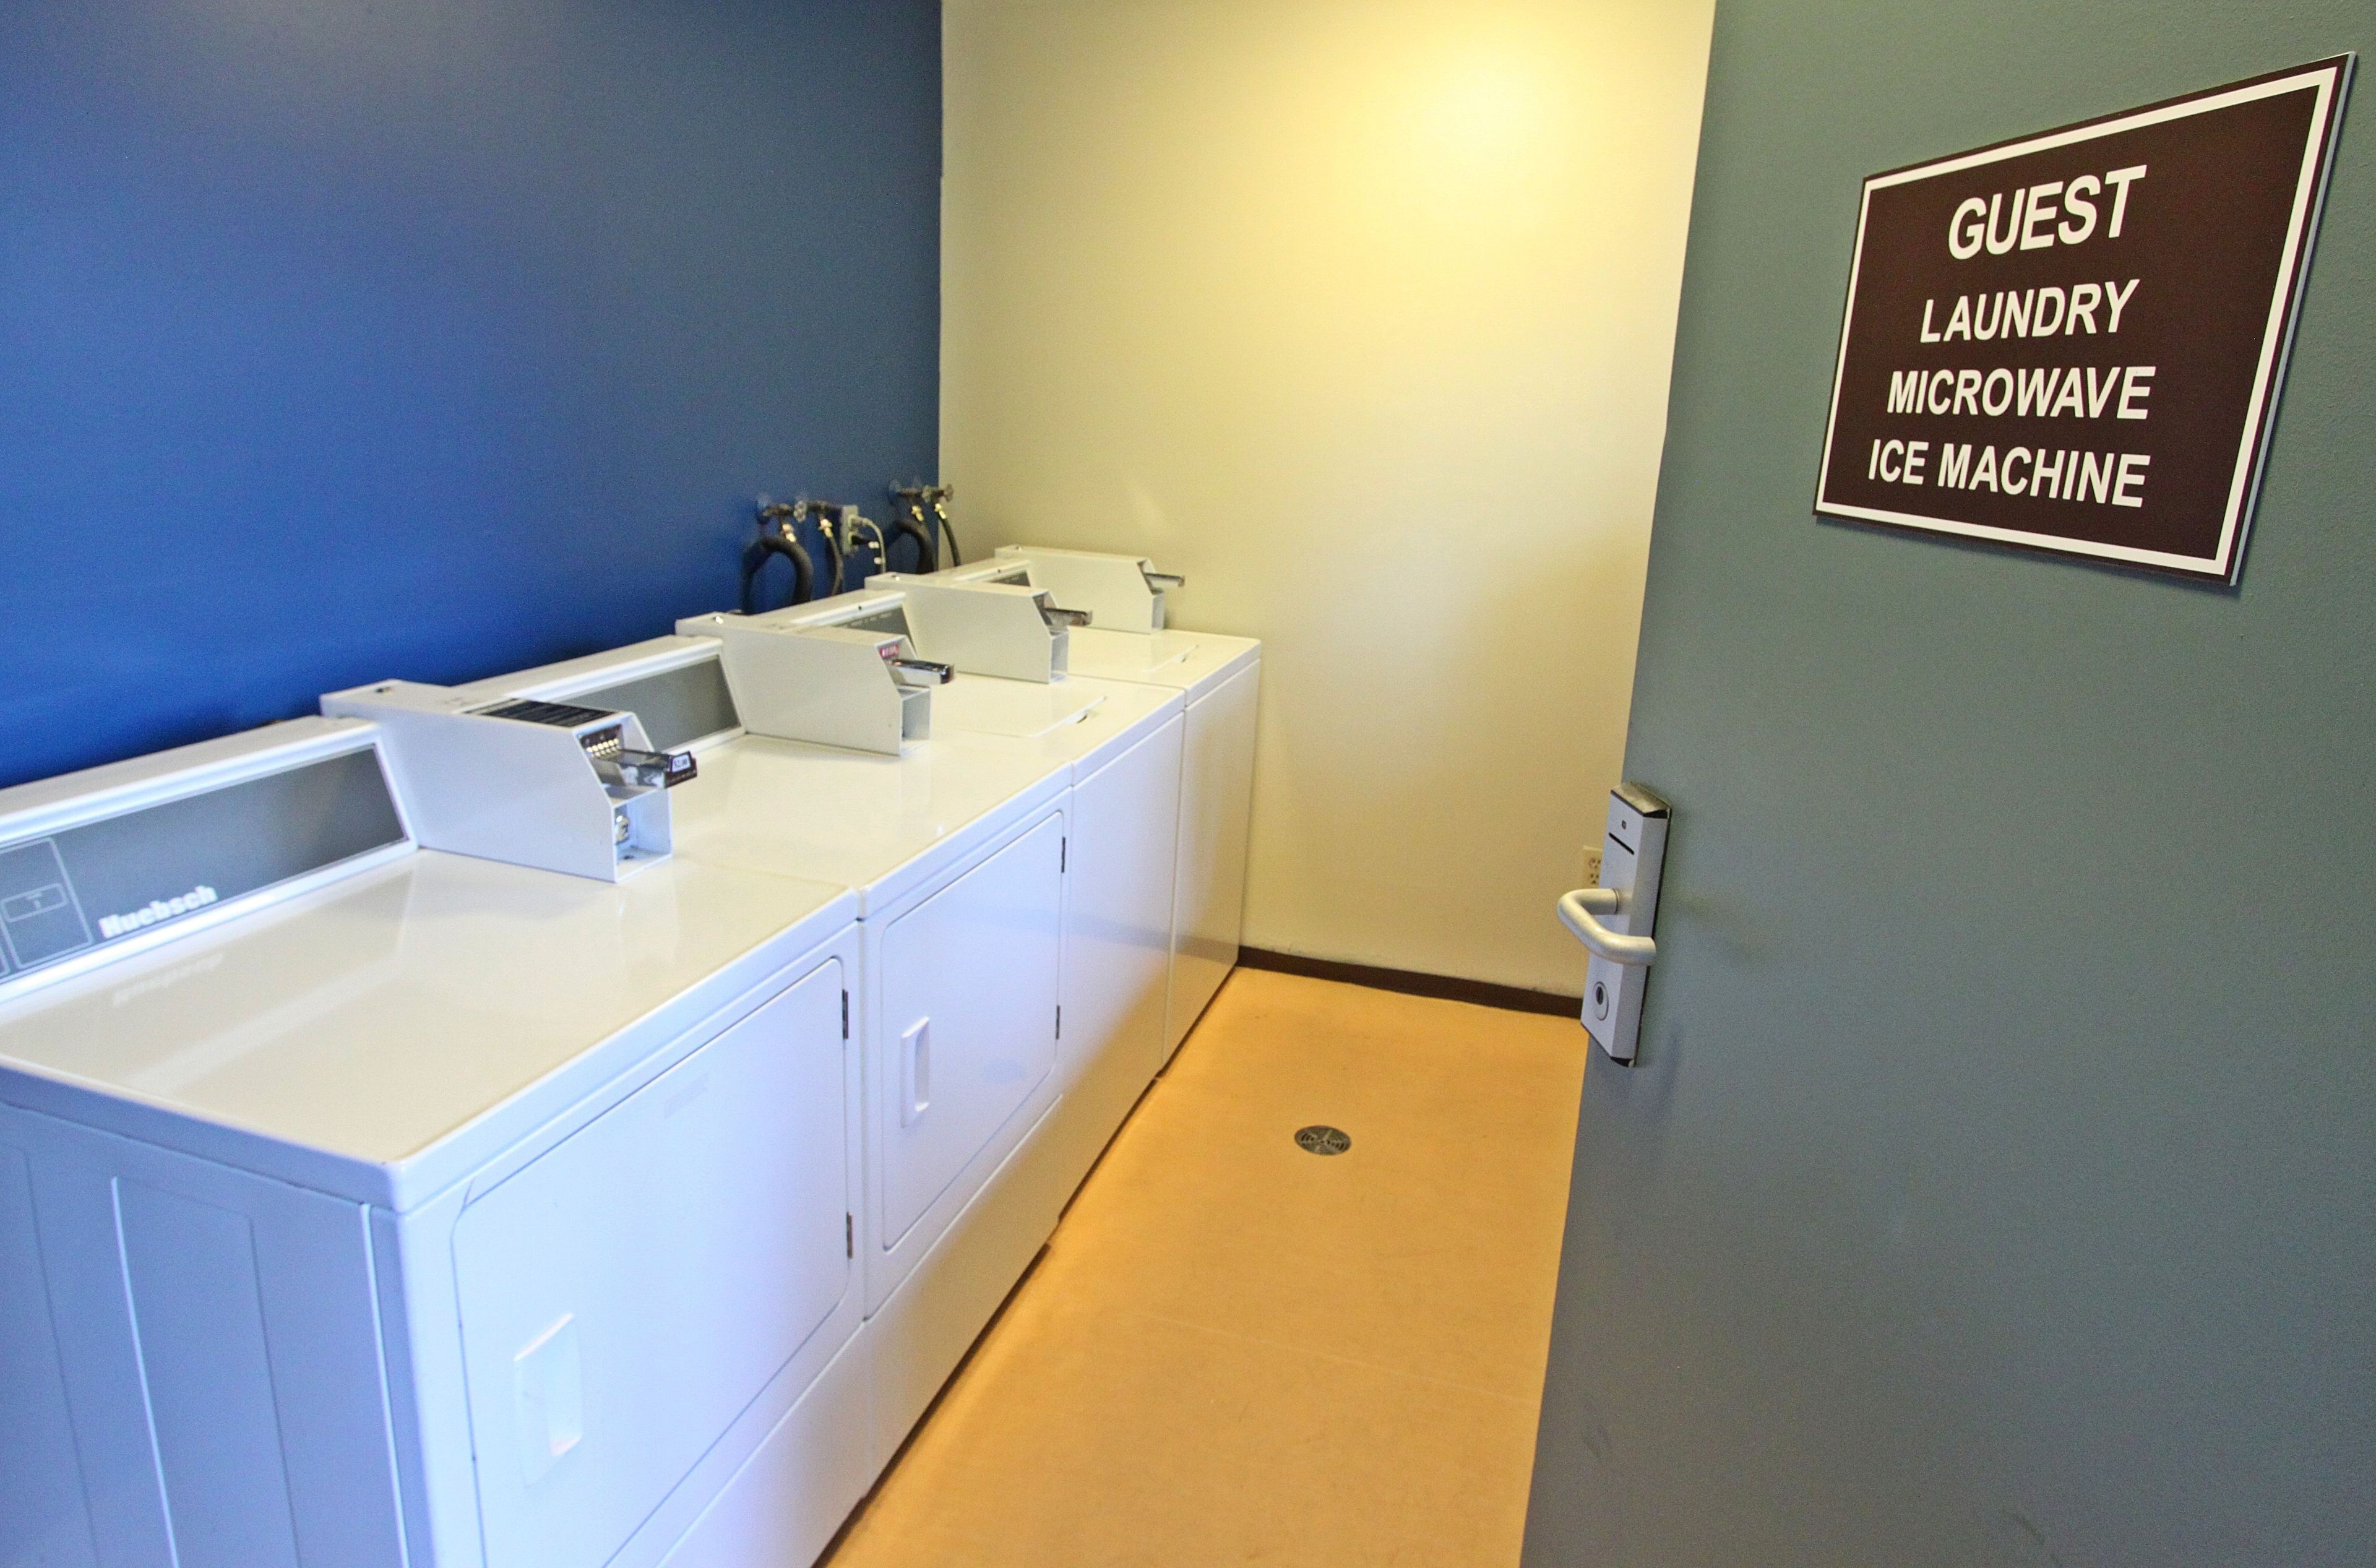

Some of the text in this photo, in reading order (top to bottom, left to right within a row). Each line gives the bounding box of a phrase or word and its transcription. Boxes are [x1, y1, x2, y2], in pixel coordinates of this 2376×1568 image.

[1948, 164, 2147, 260] GUEST
[1920, 278, 2140, 343] LAUNDRY
[1887, 366, 2156, 420] MICROWAVE
[1869, 439, 2151, 507] ICE MACHINE
[98, 885, 217, 939] Huebsch
